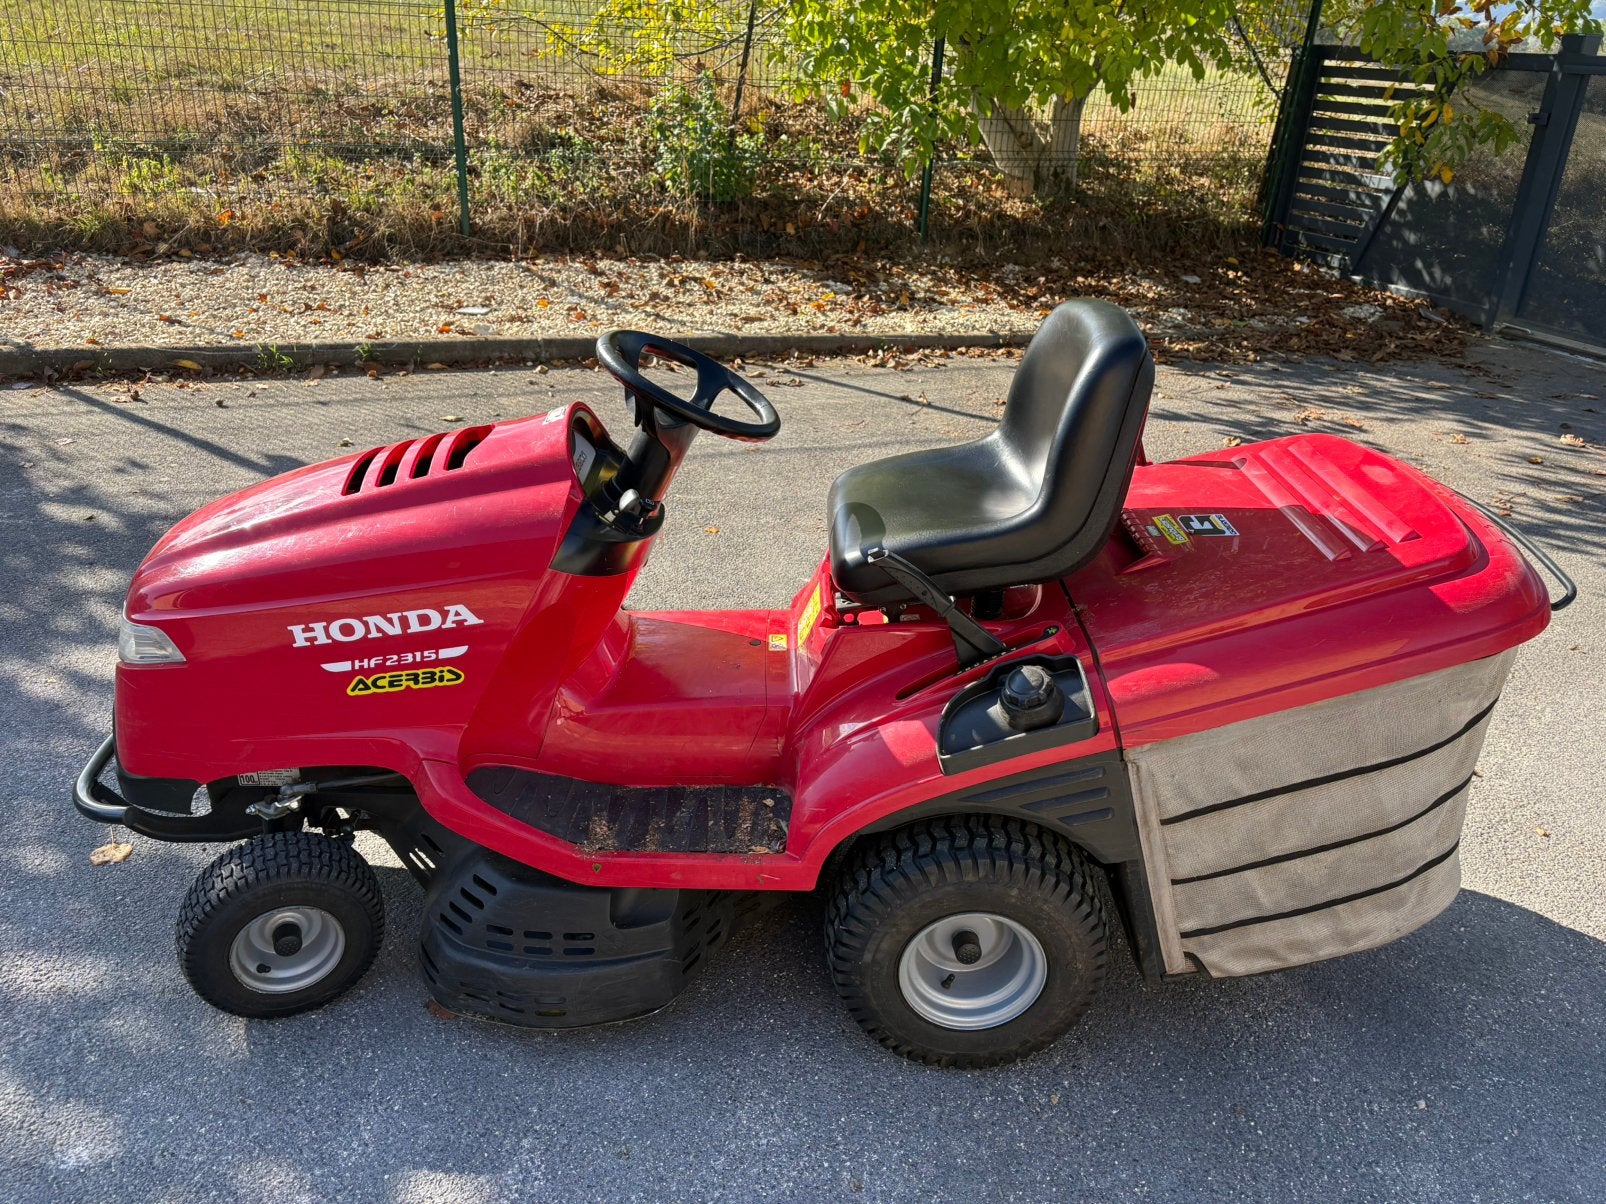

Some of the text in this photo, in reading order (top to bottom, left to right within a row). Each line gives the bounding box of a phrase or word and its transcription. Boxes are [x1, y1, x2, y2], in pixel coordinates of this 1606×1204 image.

[287, 604, 484, 648] HONDA
[354, 649, 436, 670] HF2315
[240, 774, 255, 784] 100
